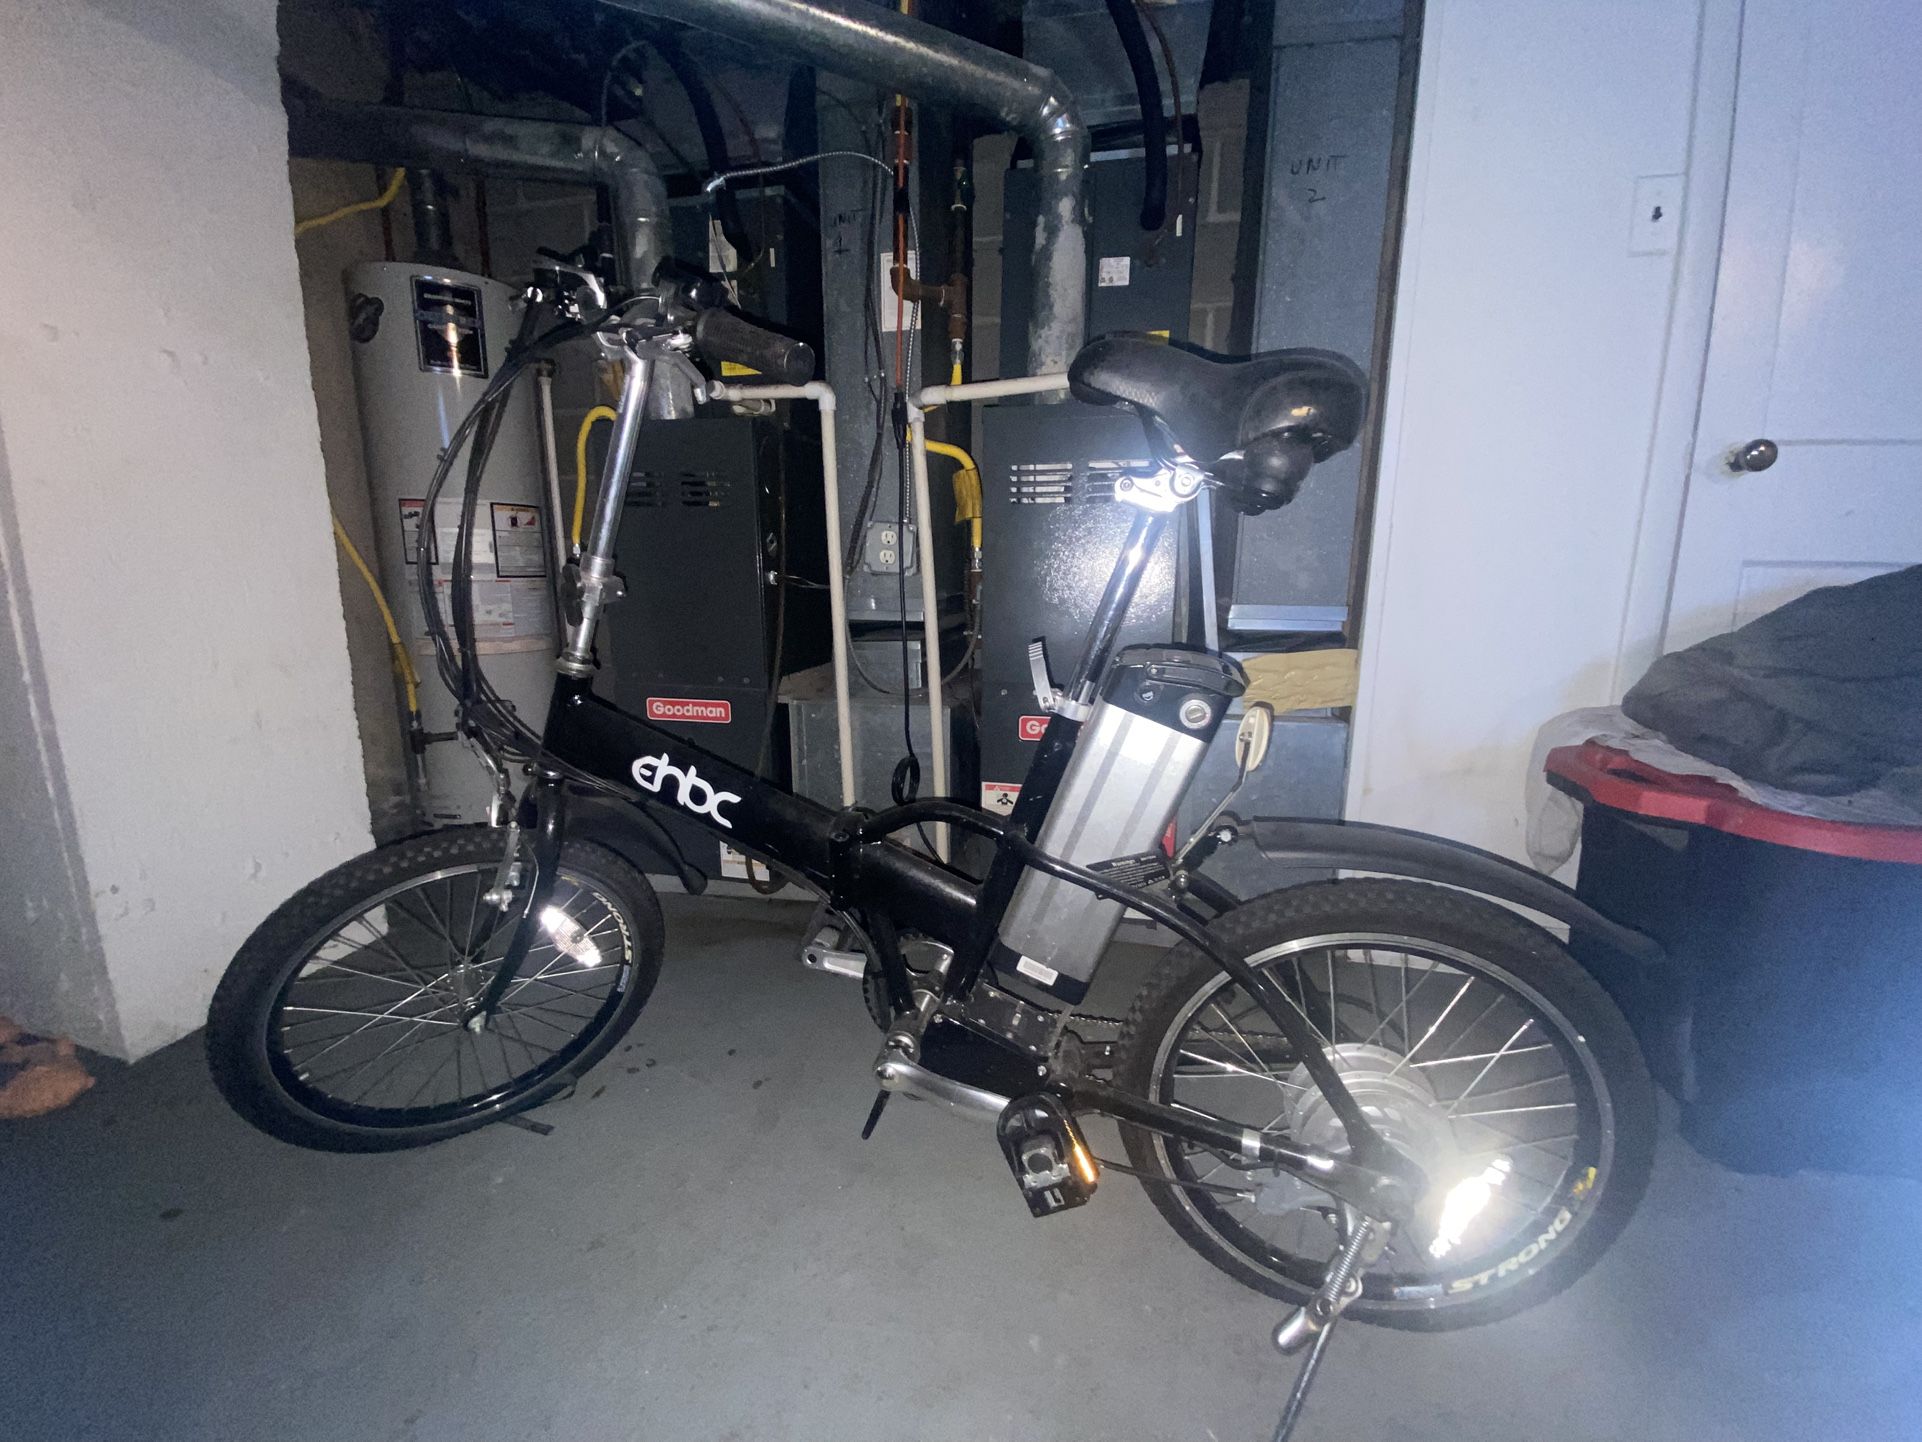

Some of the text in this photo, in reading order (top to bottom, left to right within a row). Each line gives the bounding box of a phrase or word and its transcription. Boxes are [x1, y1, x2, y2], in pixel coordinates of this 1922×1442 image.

[1291, 154, 1349, 175] UNIT
[1307, 188, 1326, 203] 2
[652, 702, 725, 717] Goodman
[1448, 1206, 1573, 1293] STRONG
